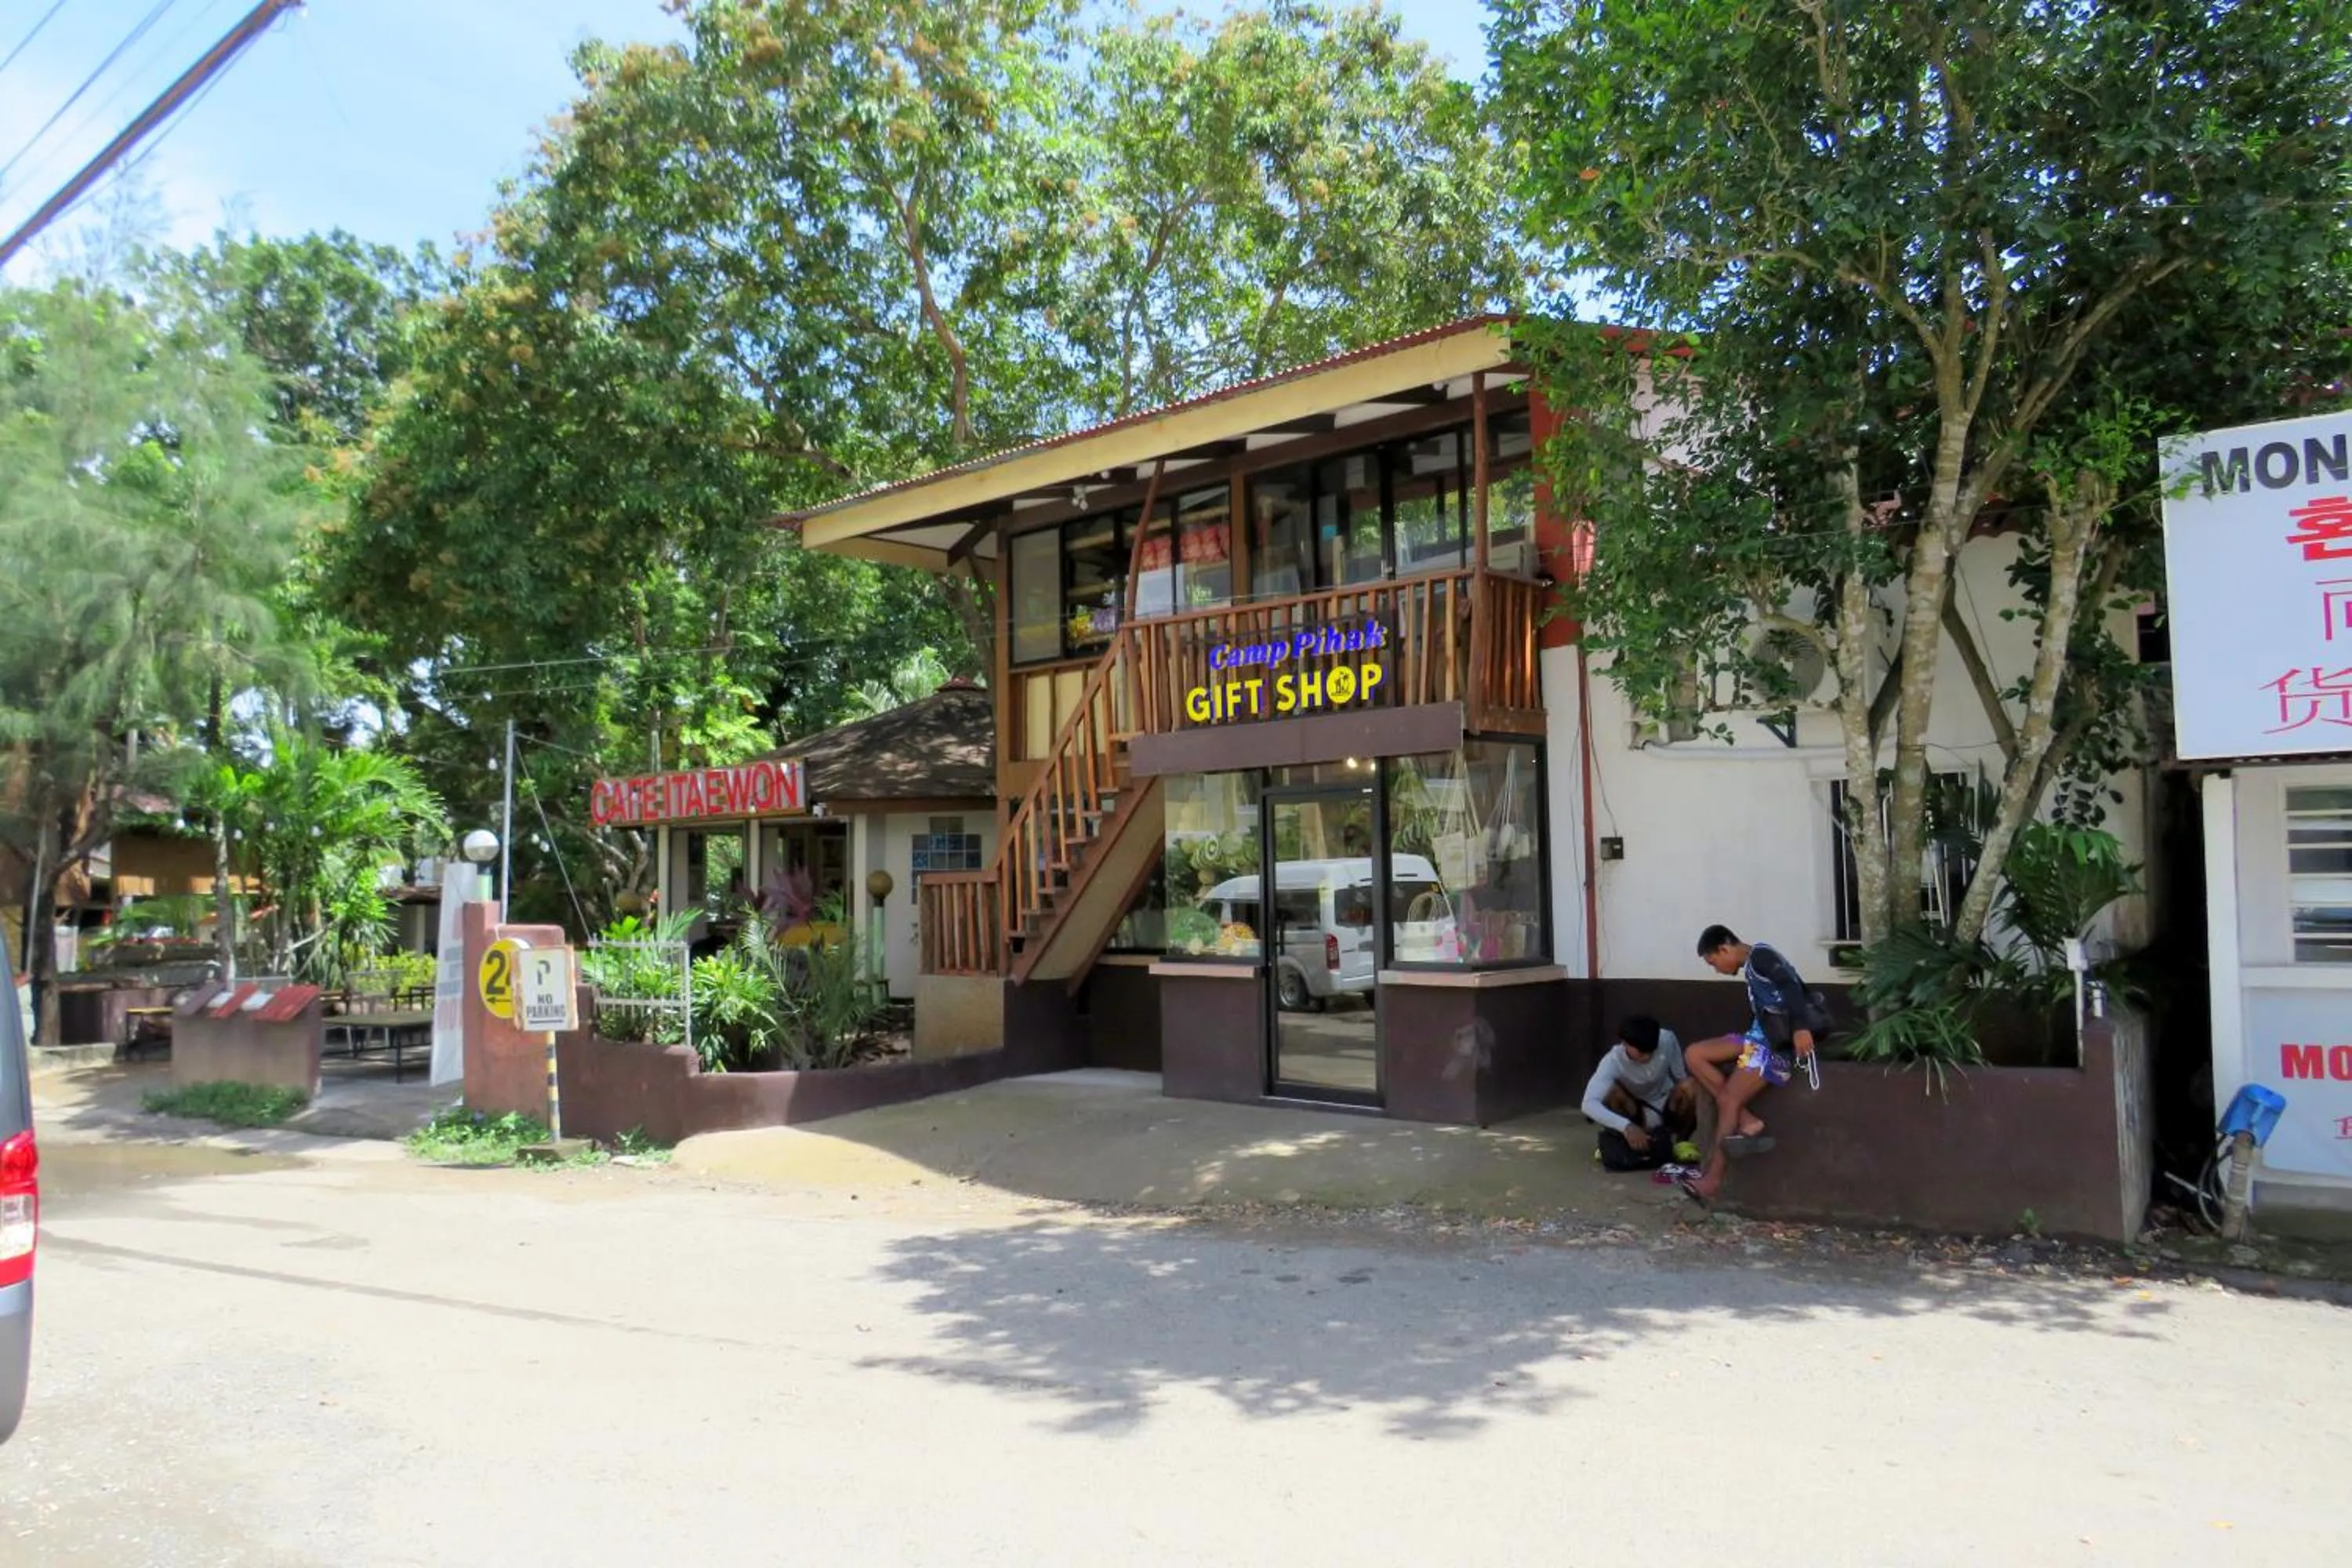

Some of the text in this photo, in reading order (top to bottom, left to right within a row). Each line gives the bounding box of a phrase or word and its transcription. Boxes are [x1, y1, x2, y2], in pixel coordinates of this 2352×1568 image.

[1209, 619, 1387, 670] Camp Pihak
[1186, 663, 1382, 722] GIFT SHOP
[661, 760, 798, 820] ITAEWON
[537, 994, 553, 1004] NO
